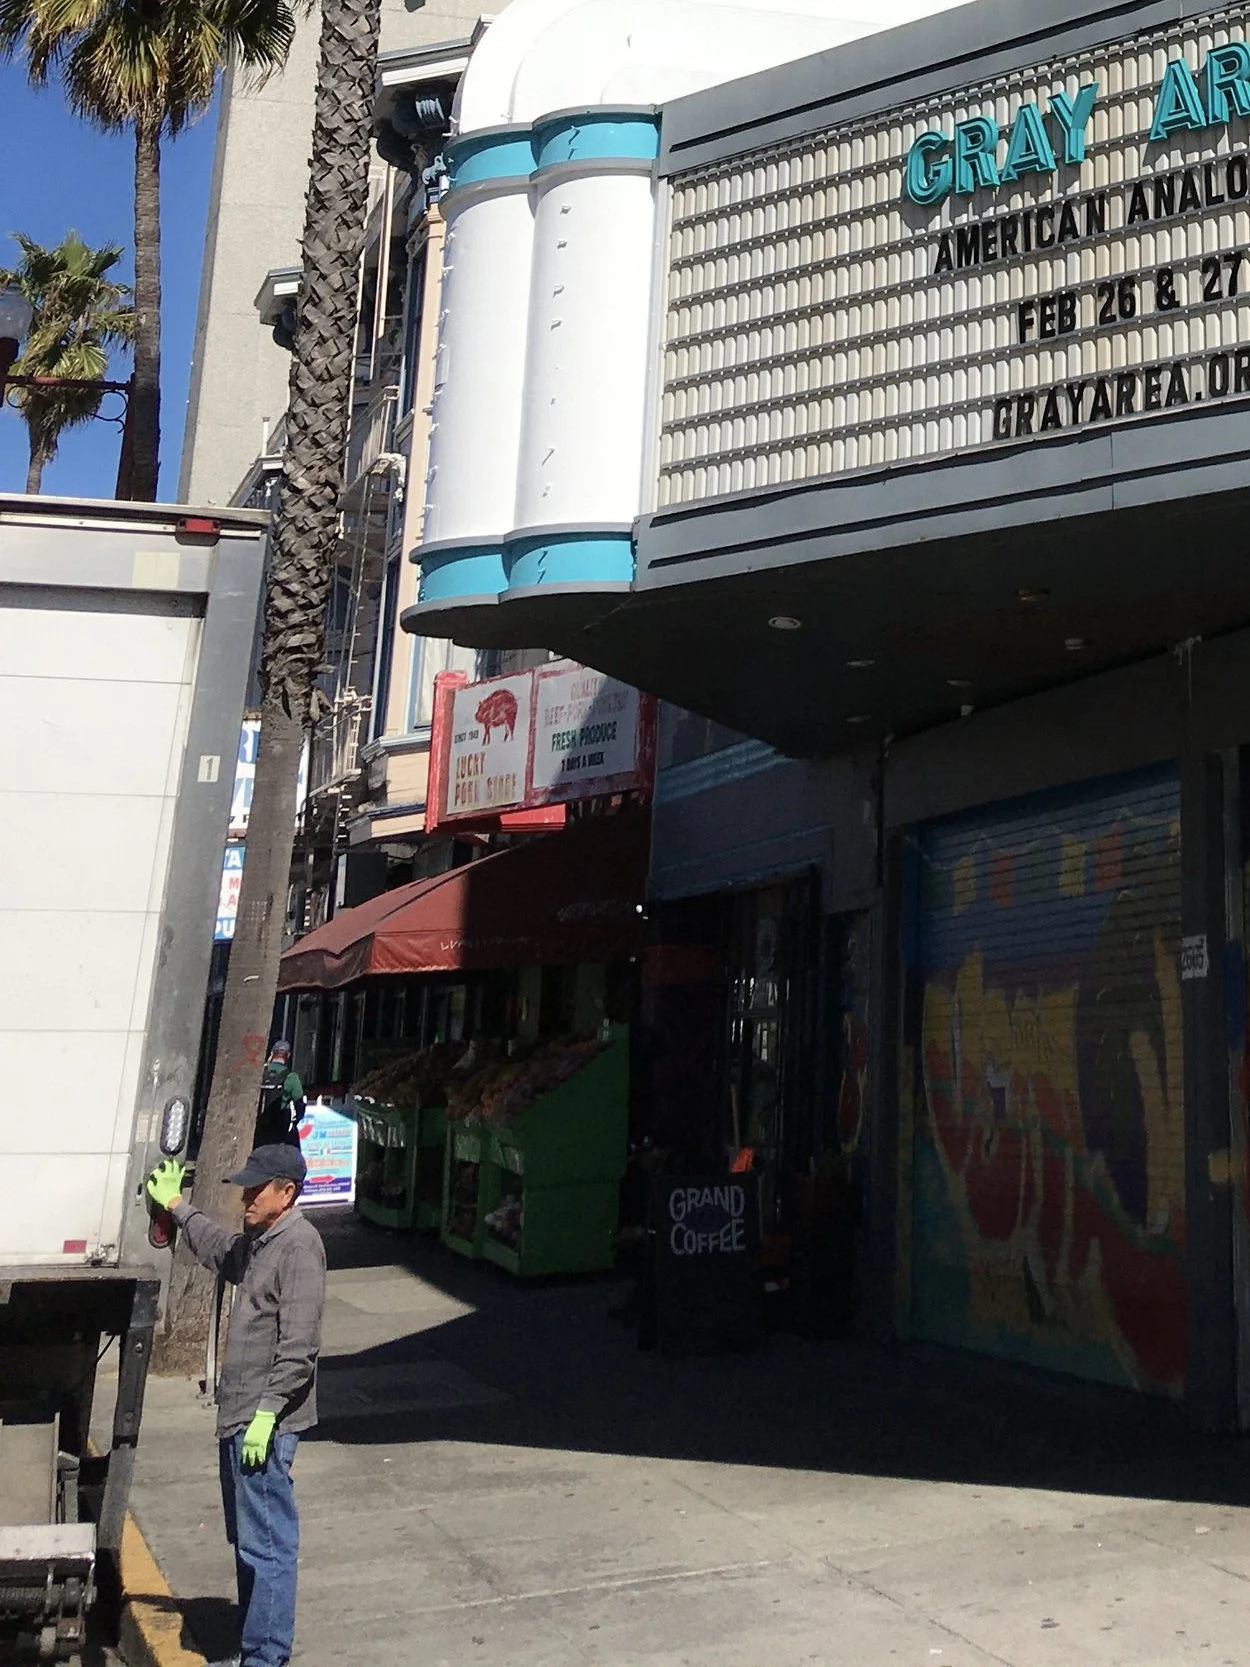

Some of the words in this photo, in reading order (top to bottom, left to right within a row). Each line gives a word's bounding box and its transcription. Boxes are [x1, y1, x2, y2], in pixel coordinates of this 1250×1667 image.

[907, 81, 1100, 205] GRAY
[933, 192, 1104, 275] AMERICAN
[1017, 291, 1076, 344] FEB
[1098, 277, 1136, 325] 26
[1156, 267, 1180, 311] &
[1202, 252, 1243, 302] 27
[551, 728, 577, 752] FRESH
[580, 721, 617, 747] PRODUCE
[206, 757, 214, 781] 1
[456, 751, 486, 780] LUCKY
[669, 1186, 745, 1221] GRAND
[670, 1219, 746, 1255] COFFEE
